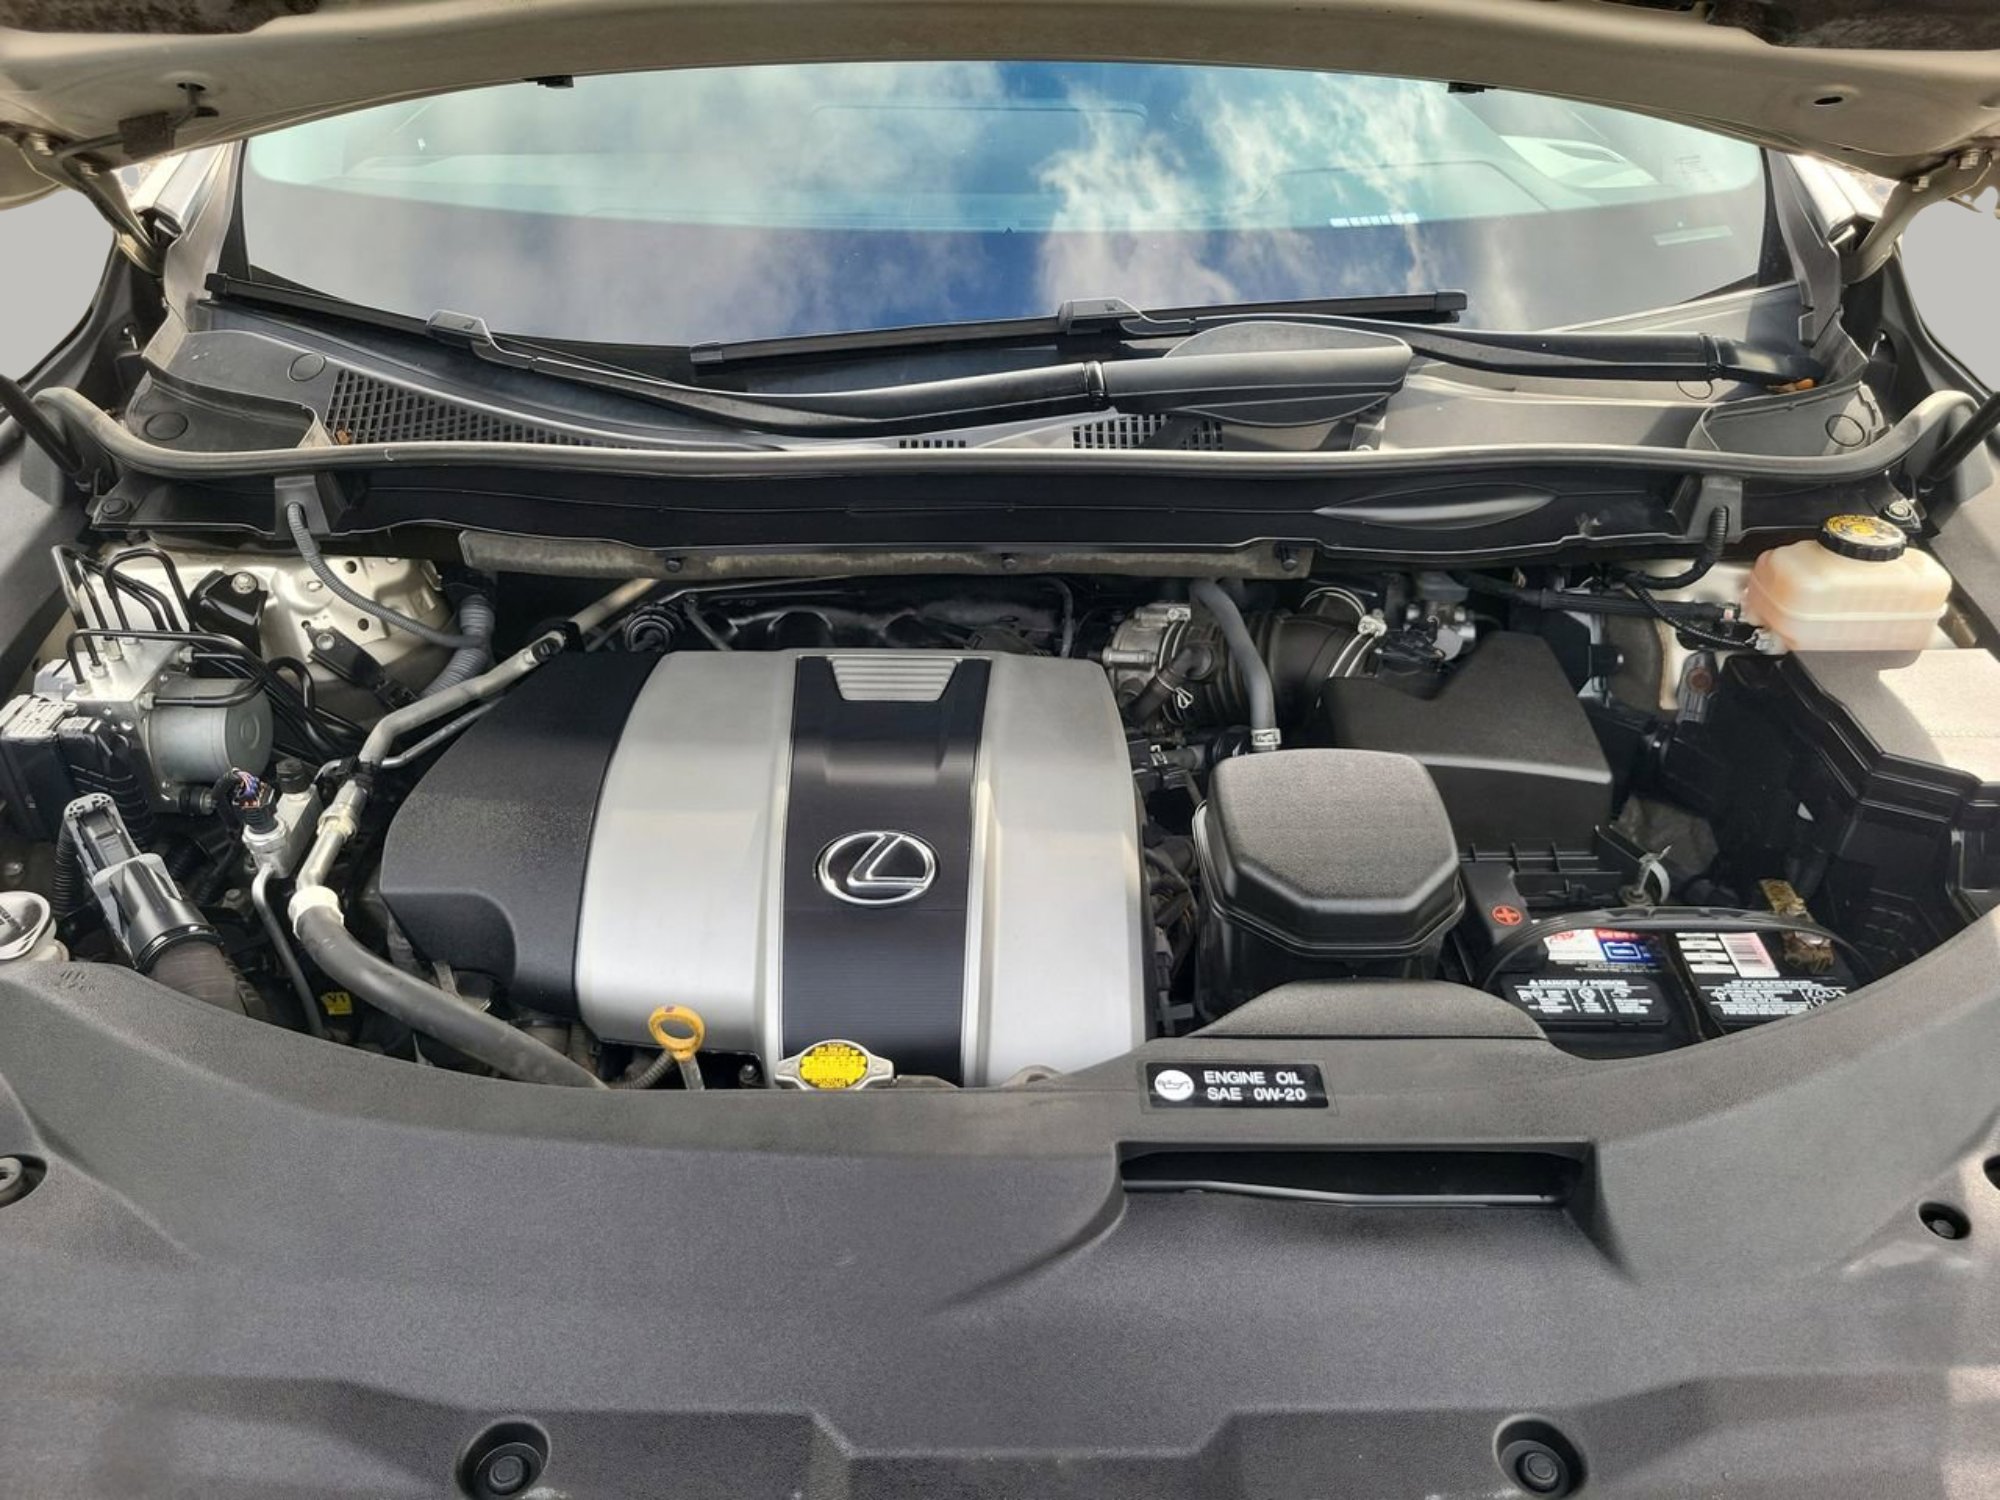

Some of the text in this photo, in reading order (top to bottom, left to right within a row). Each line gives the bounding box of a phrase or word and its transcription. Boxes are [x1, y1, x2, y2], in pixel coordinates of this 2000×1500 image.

[1203, 1070, 1305, 1085] ENGINE OIL
[1207, 1087, 1307, 1101] SAE 0W-20
